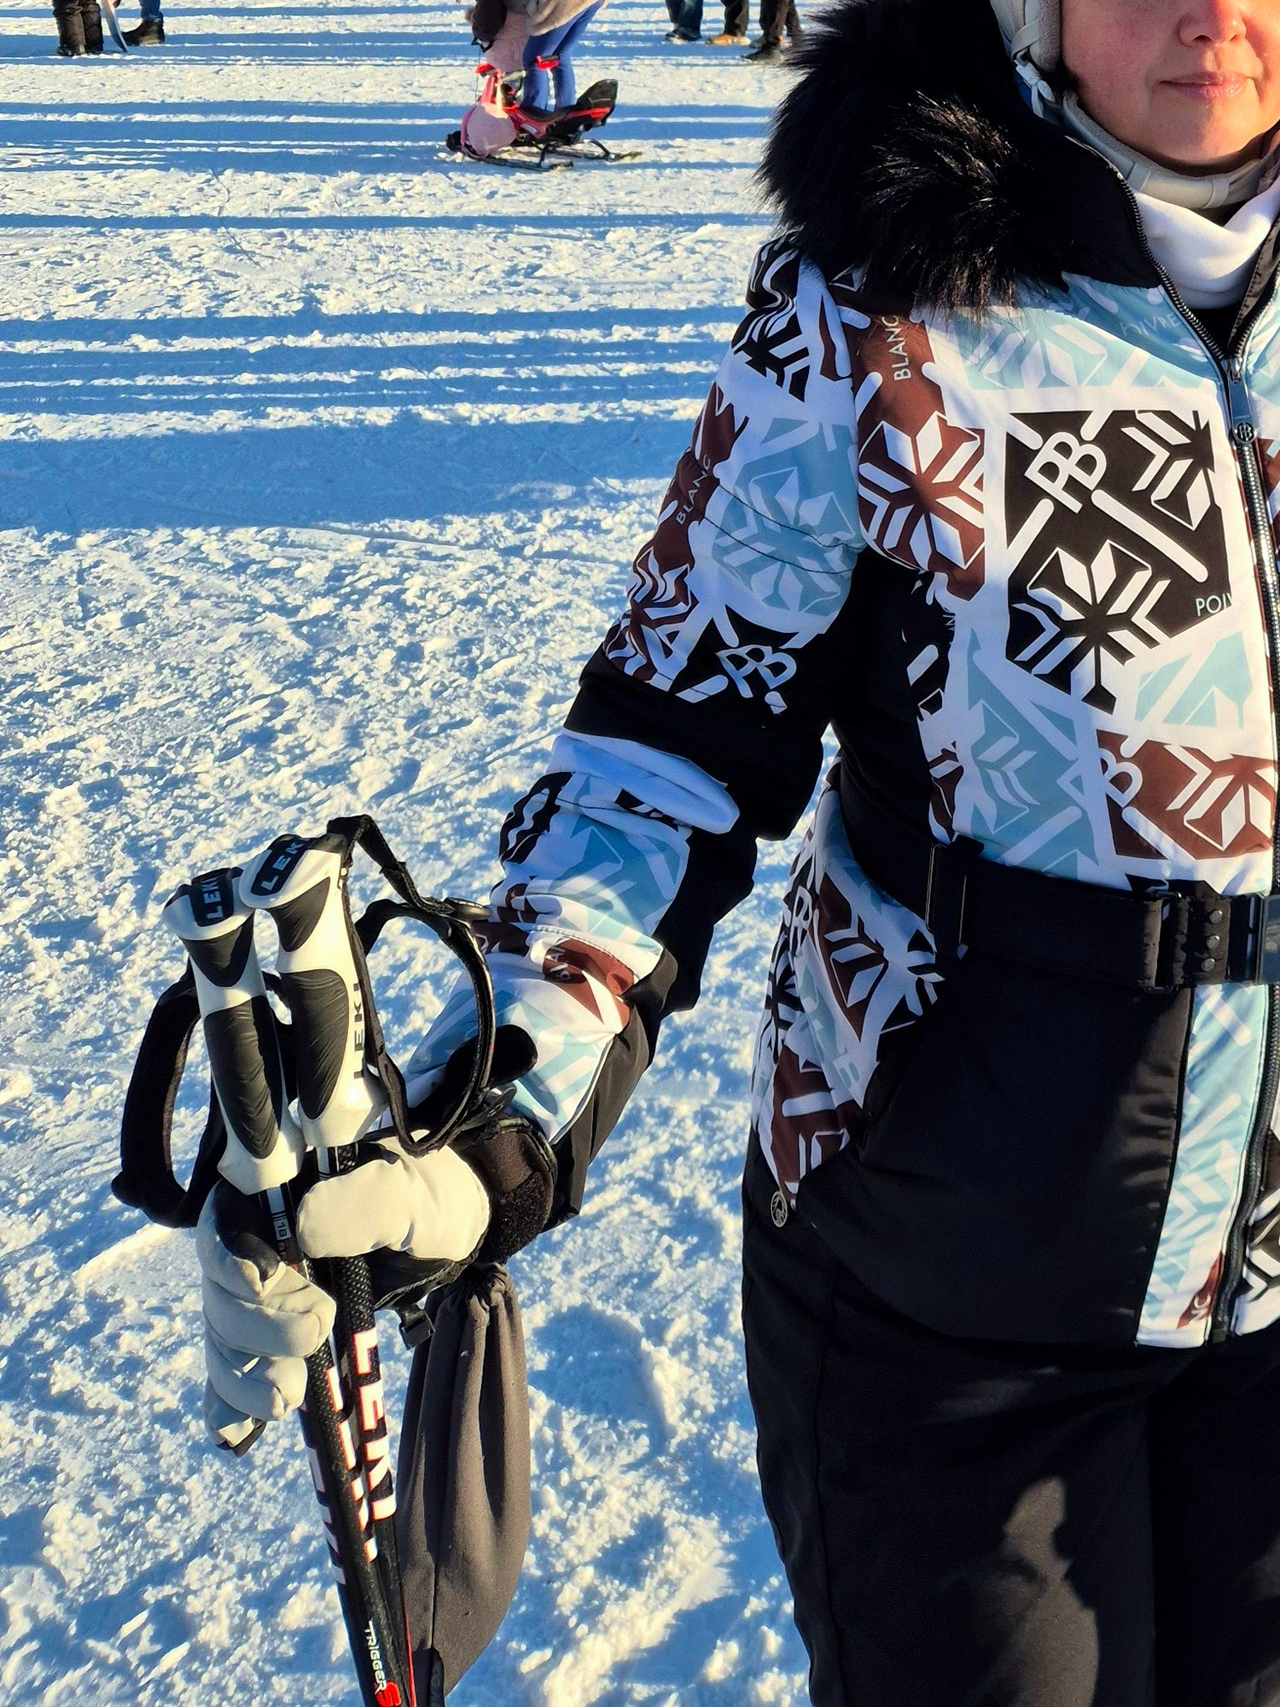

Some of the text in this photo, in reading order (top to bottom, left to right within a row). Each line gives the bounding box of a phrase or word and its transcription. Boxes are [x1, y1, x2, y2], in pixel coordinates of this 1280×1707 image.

[881, 315, 912, 381] BLANC
[676, 454, 711, 525] BLANC
[353, 982, 366, 1080] LEKI
[353, 1327, 397, 1521] LEKI
[364, 1618, 387, 1695] TRIGGER
